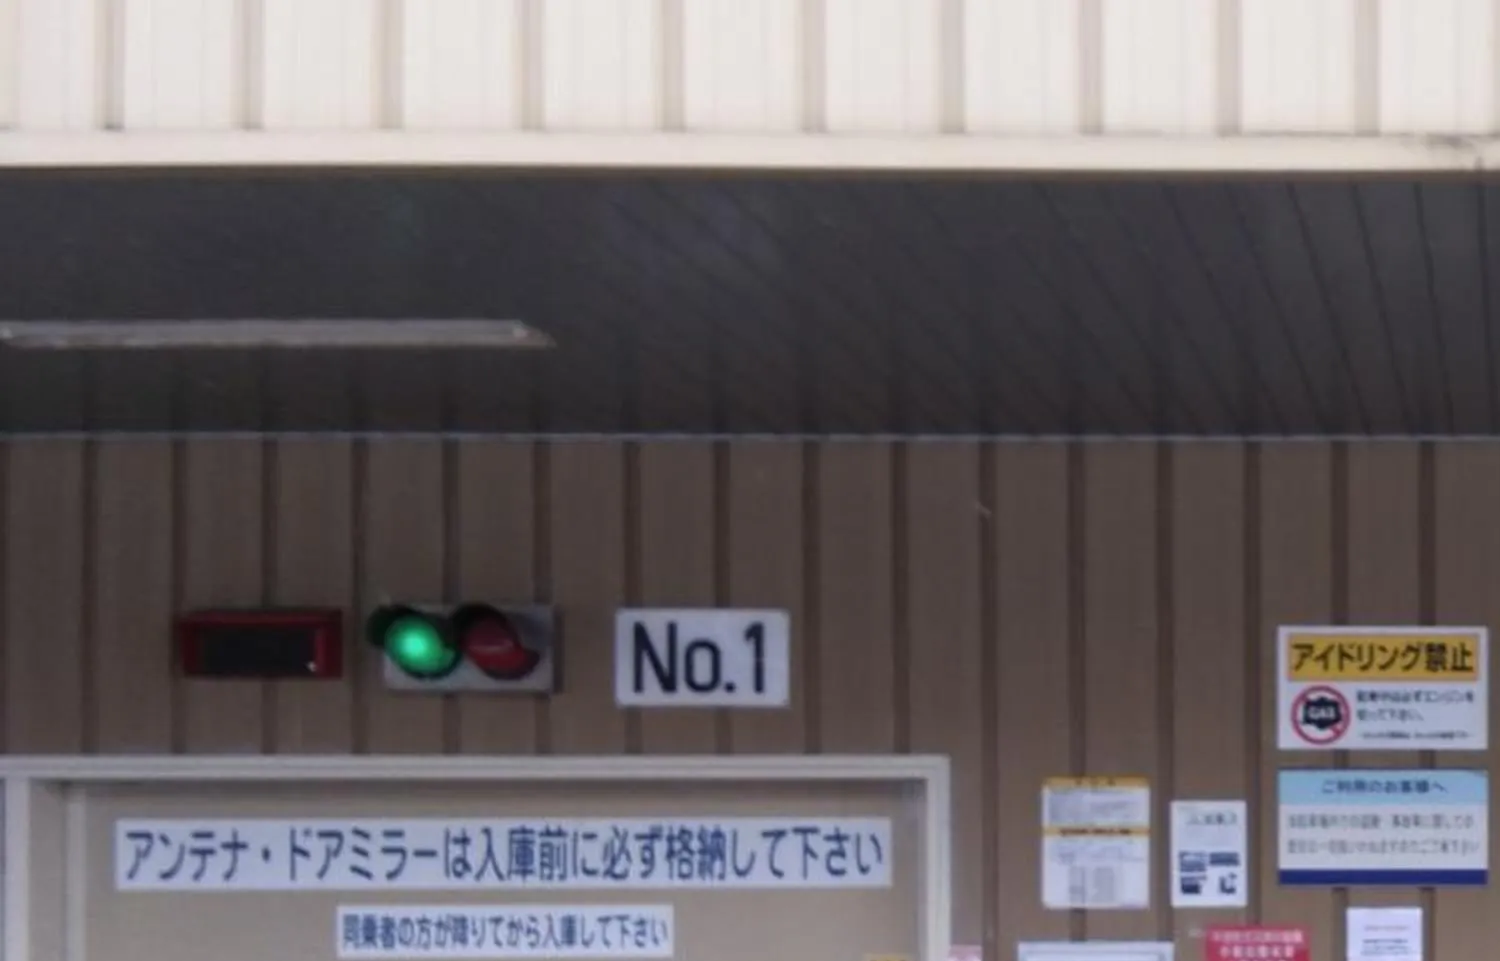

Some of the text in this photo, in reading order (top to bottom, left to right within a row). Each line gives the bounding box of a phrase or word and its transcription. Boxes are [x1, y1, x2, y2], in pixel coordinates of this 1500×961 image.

[631, 622, 767, 695] No.1
[1291, 642, 1474, 672] アイドリング禁止
[125, 826, 883, 881] アンテナ・ドアミラーは入庫前に必ず格納して下さい
[343, 913, 669, 949] 同乗者の方が降りてから入庫して下さい
